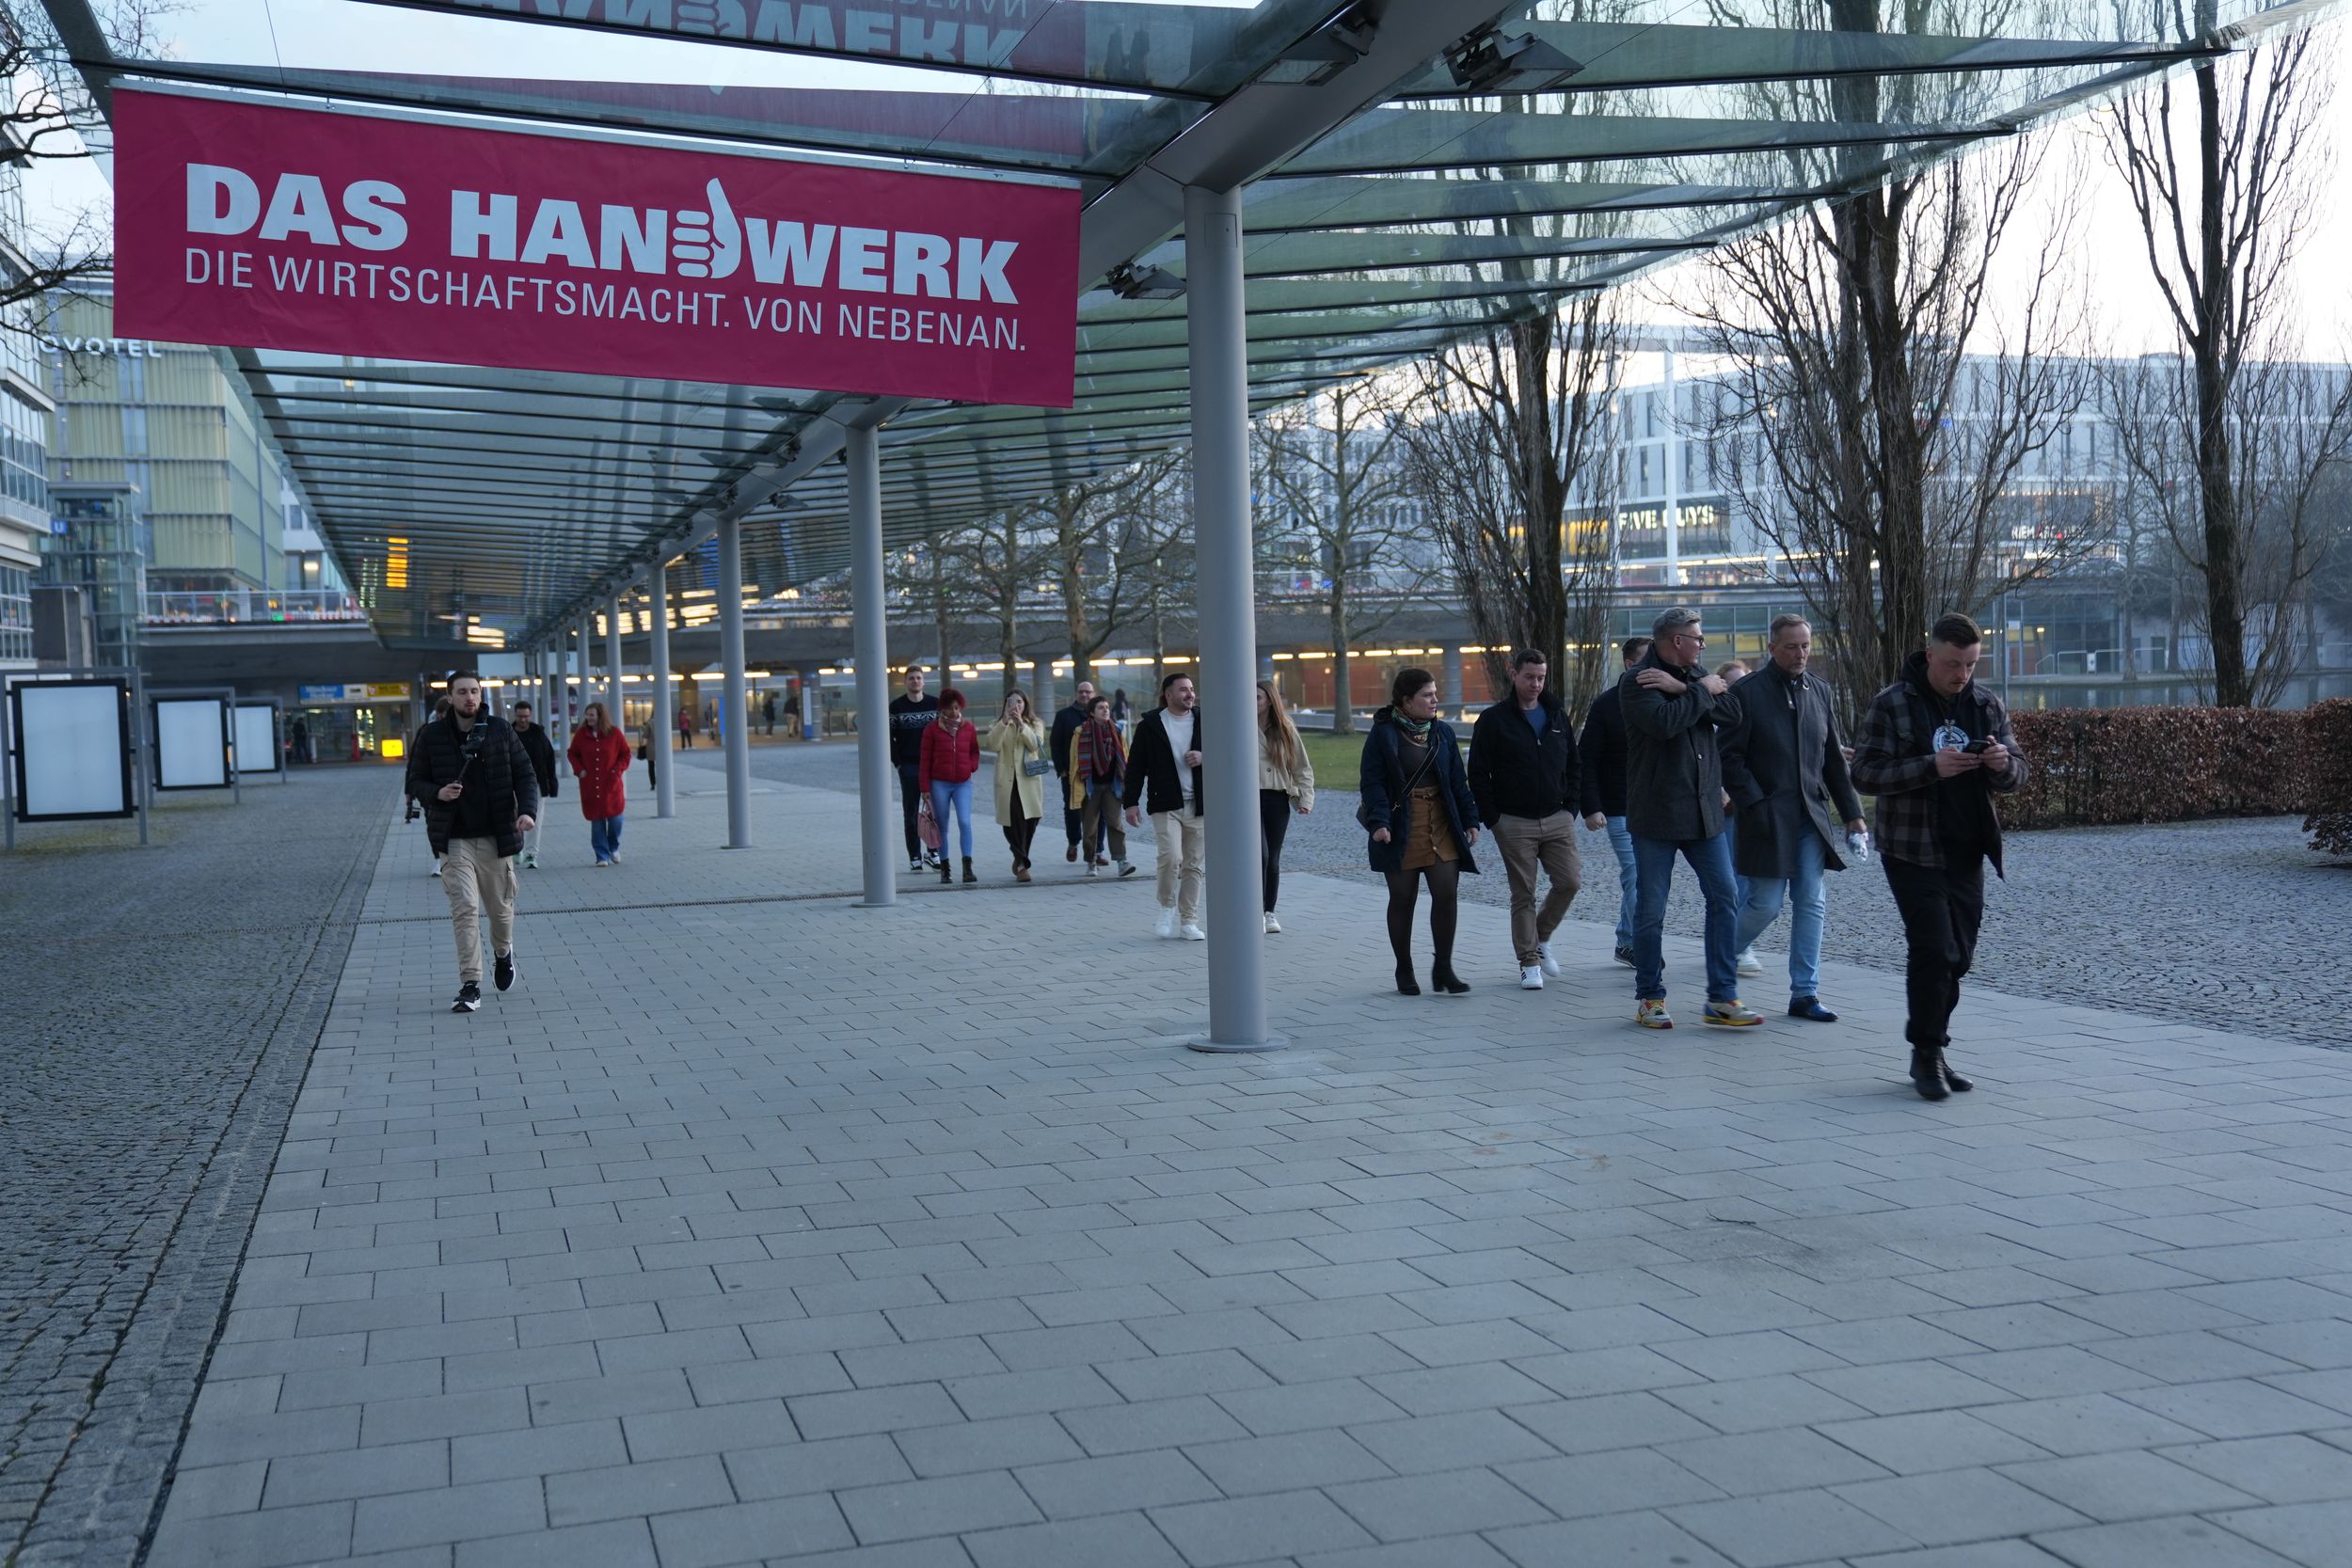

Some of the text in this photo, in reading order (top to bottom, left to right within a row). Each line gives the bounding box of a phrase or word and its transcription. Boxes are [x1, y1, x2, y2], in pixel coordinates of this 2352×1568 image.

[186, 163, 408, 251] DAS
[185, 247, 1026, 351] DIE WIRTSCHAFTSMACHT. VON NEBENAN.
[39, 334, 163, 358] OVOTEL
[54, 521, 65, 533] U
[1618, 510, 1658, 531] FIVE
